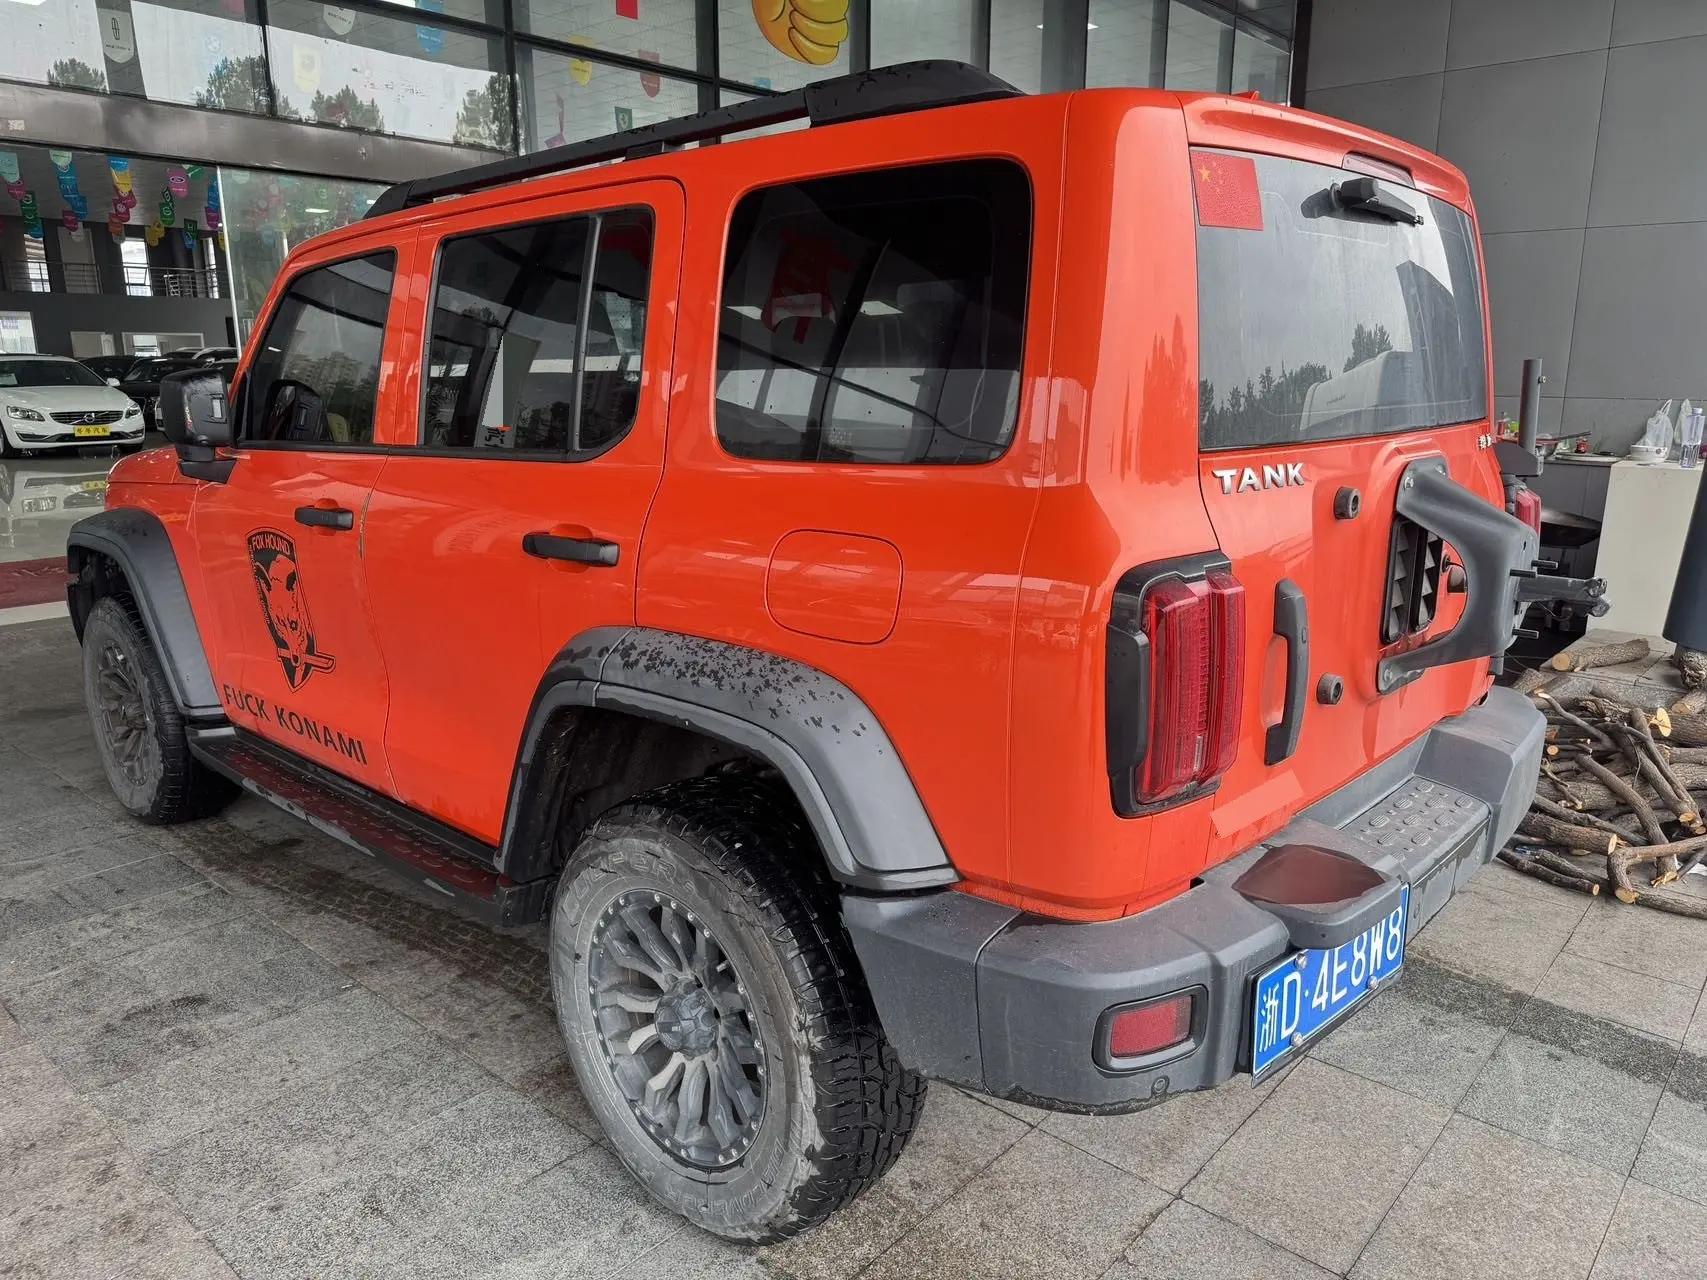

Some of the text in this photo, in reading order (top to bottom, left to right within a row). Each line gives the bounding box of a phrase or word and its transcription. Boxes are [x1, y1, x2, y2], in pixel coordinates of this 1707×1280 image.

[1212, 462, 1304, 494] TANK
[223, 684, 367, 765] FUCK KONAMI
